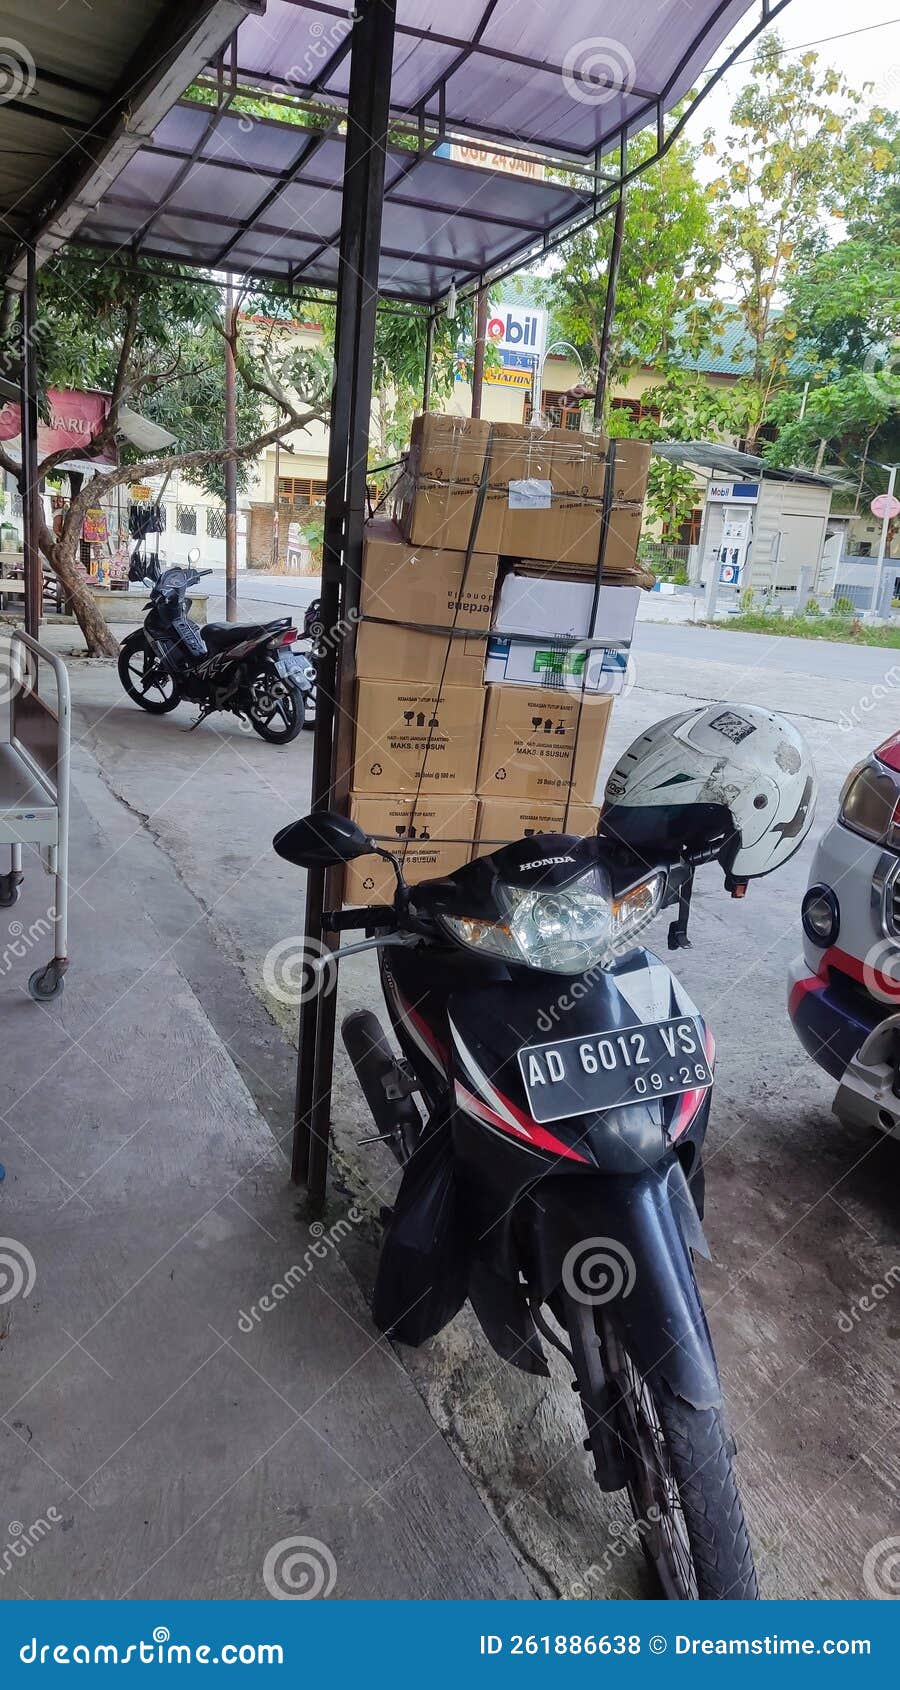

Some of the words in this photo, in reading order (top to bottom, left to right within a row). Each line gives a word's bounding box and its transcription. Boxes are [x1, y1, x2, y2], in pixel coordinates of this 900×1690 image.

[487, 313, 537, 346] obil
[710, 487, 730, 497] Mobil
[447, 601, 491, 614] erdana
[519, 856, 577, 872] HONDA
[529, 1050, 566, 1087] AD
[579, 1033, 650, 1075] 6012
[659, 1024, 697, 1058] VS
